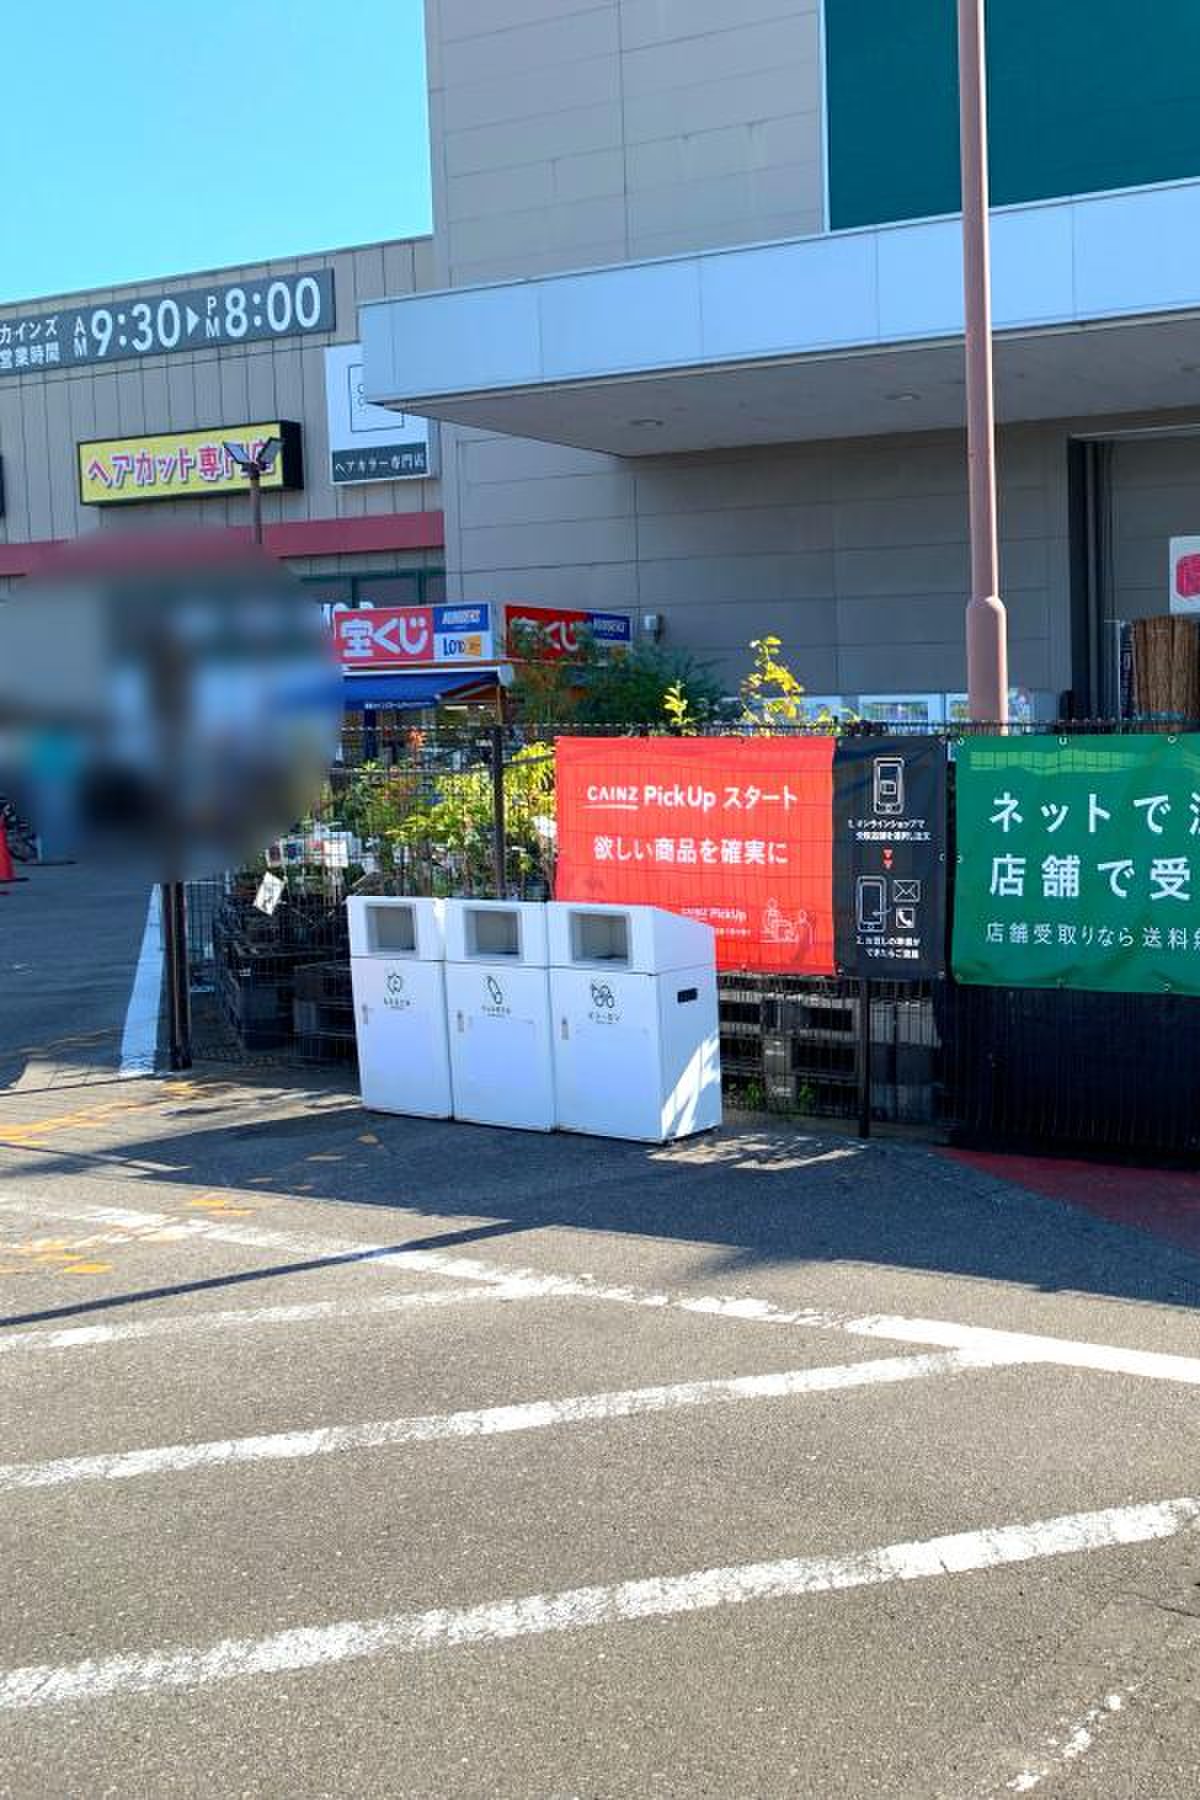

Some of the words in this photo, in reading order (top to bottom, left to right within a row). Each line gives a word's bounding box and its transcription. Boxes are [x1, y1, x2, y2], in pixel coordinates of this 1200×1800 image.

[0, 316, 57, 343] カインズ
[90, 299, 181, 356] 9:30
[224, 276, 321, 336] 8:00
[0, 344, 60, 369] 営業時間
[340, 616, 429, 657] 宝くじ
[587, 784, 638, 801] CAINZ
[643, 784, 716, 811] PickUp
[723, 785, 797, 810] スタート
[594, 837, 788, 864] 欲しい商品を確実に
